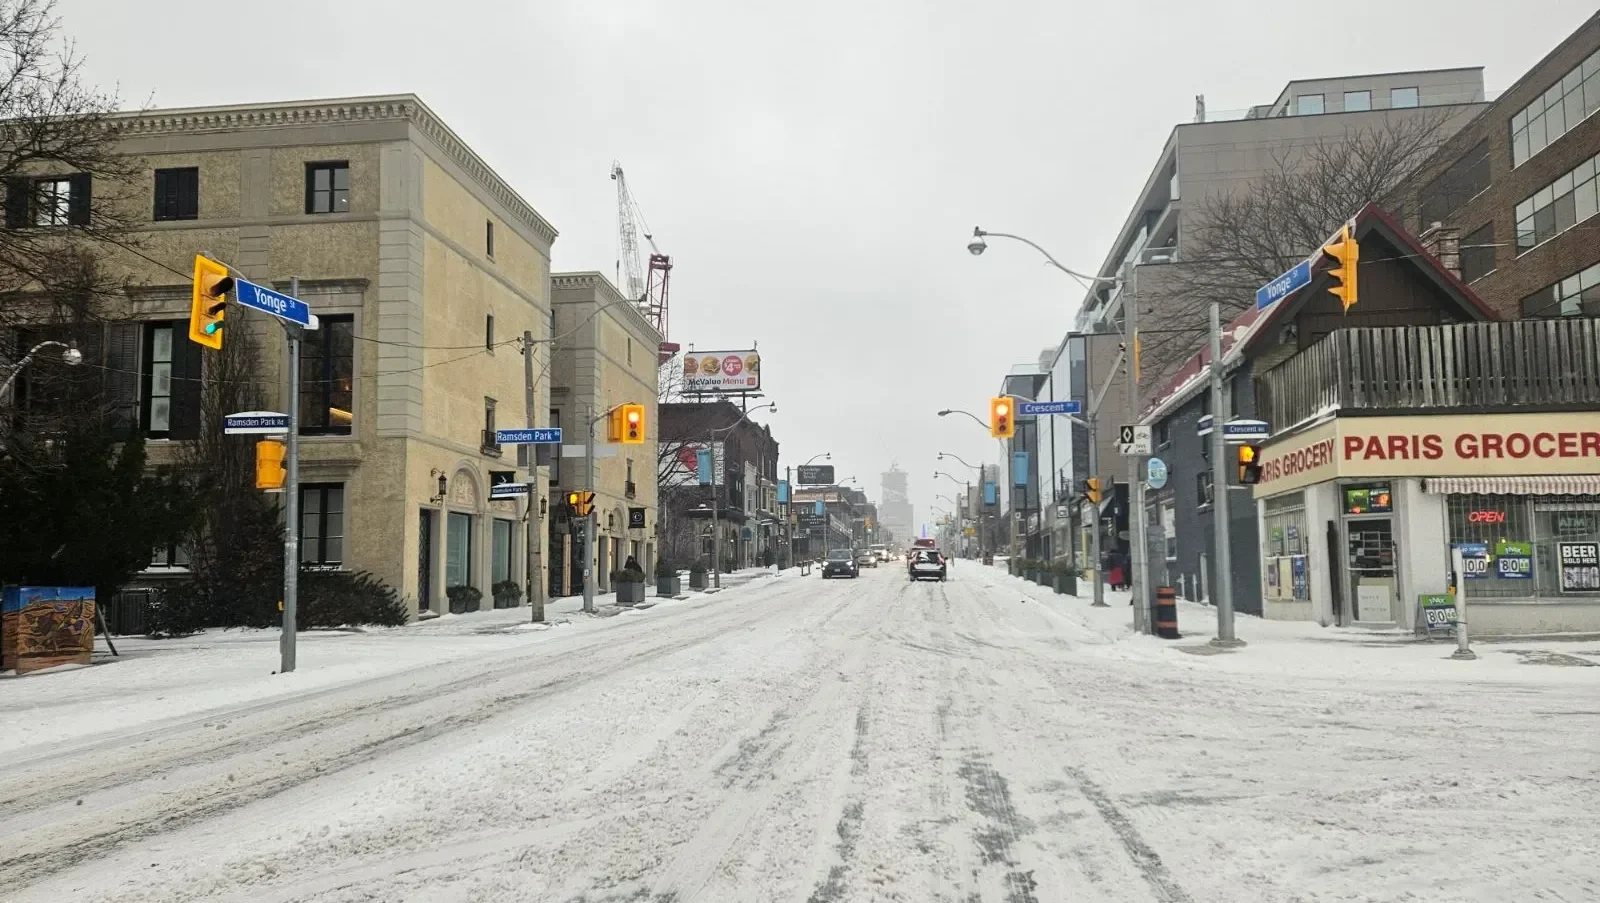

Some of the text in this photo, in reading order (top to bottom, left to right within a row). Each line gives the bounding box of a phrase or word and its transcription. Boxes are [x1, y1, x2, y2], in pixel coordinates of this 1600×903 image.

[1267, 277, 1291, 299] Yonge
[253, 287, 287, 314] Yonge
[1025, 403, 1064, 413] Crescent
[228, 418, 259, 427] Ramsden
[260, 418, 276, 426] Park
[1229, 425, 1257, 433] Crescent
[498, 432, 532, 441] Ramsden
[534, 431, 552, 440] Park
[1344, 433, 1443, 460] PARIS
[1260, 439, 1335, 483] ARIS GROCERY
[1468, 511, 1505, 522] OPEN
[1562, 545, 1597, 558] BEER
